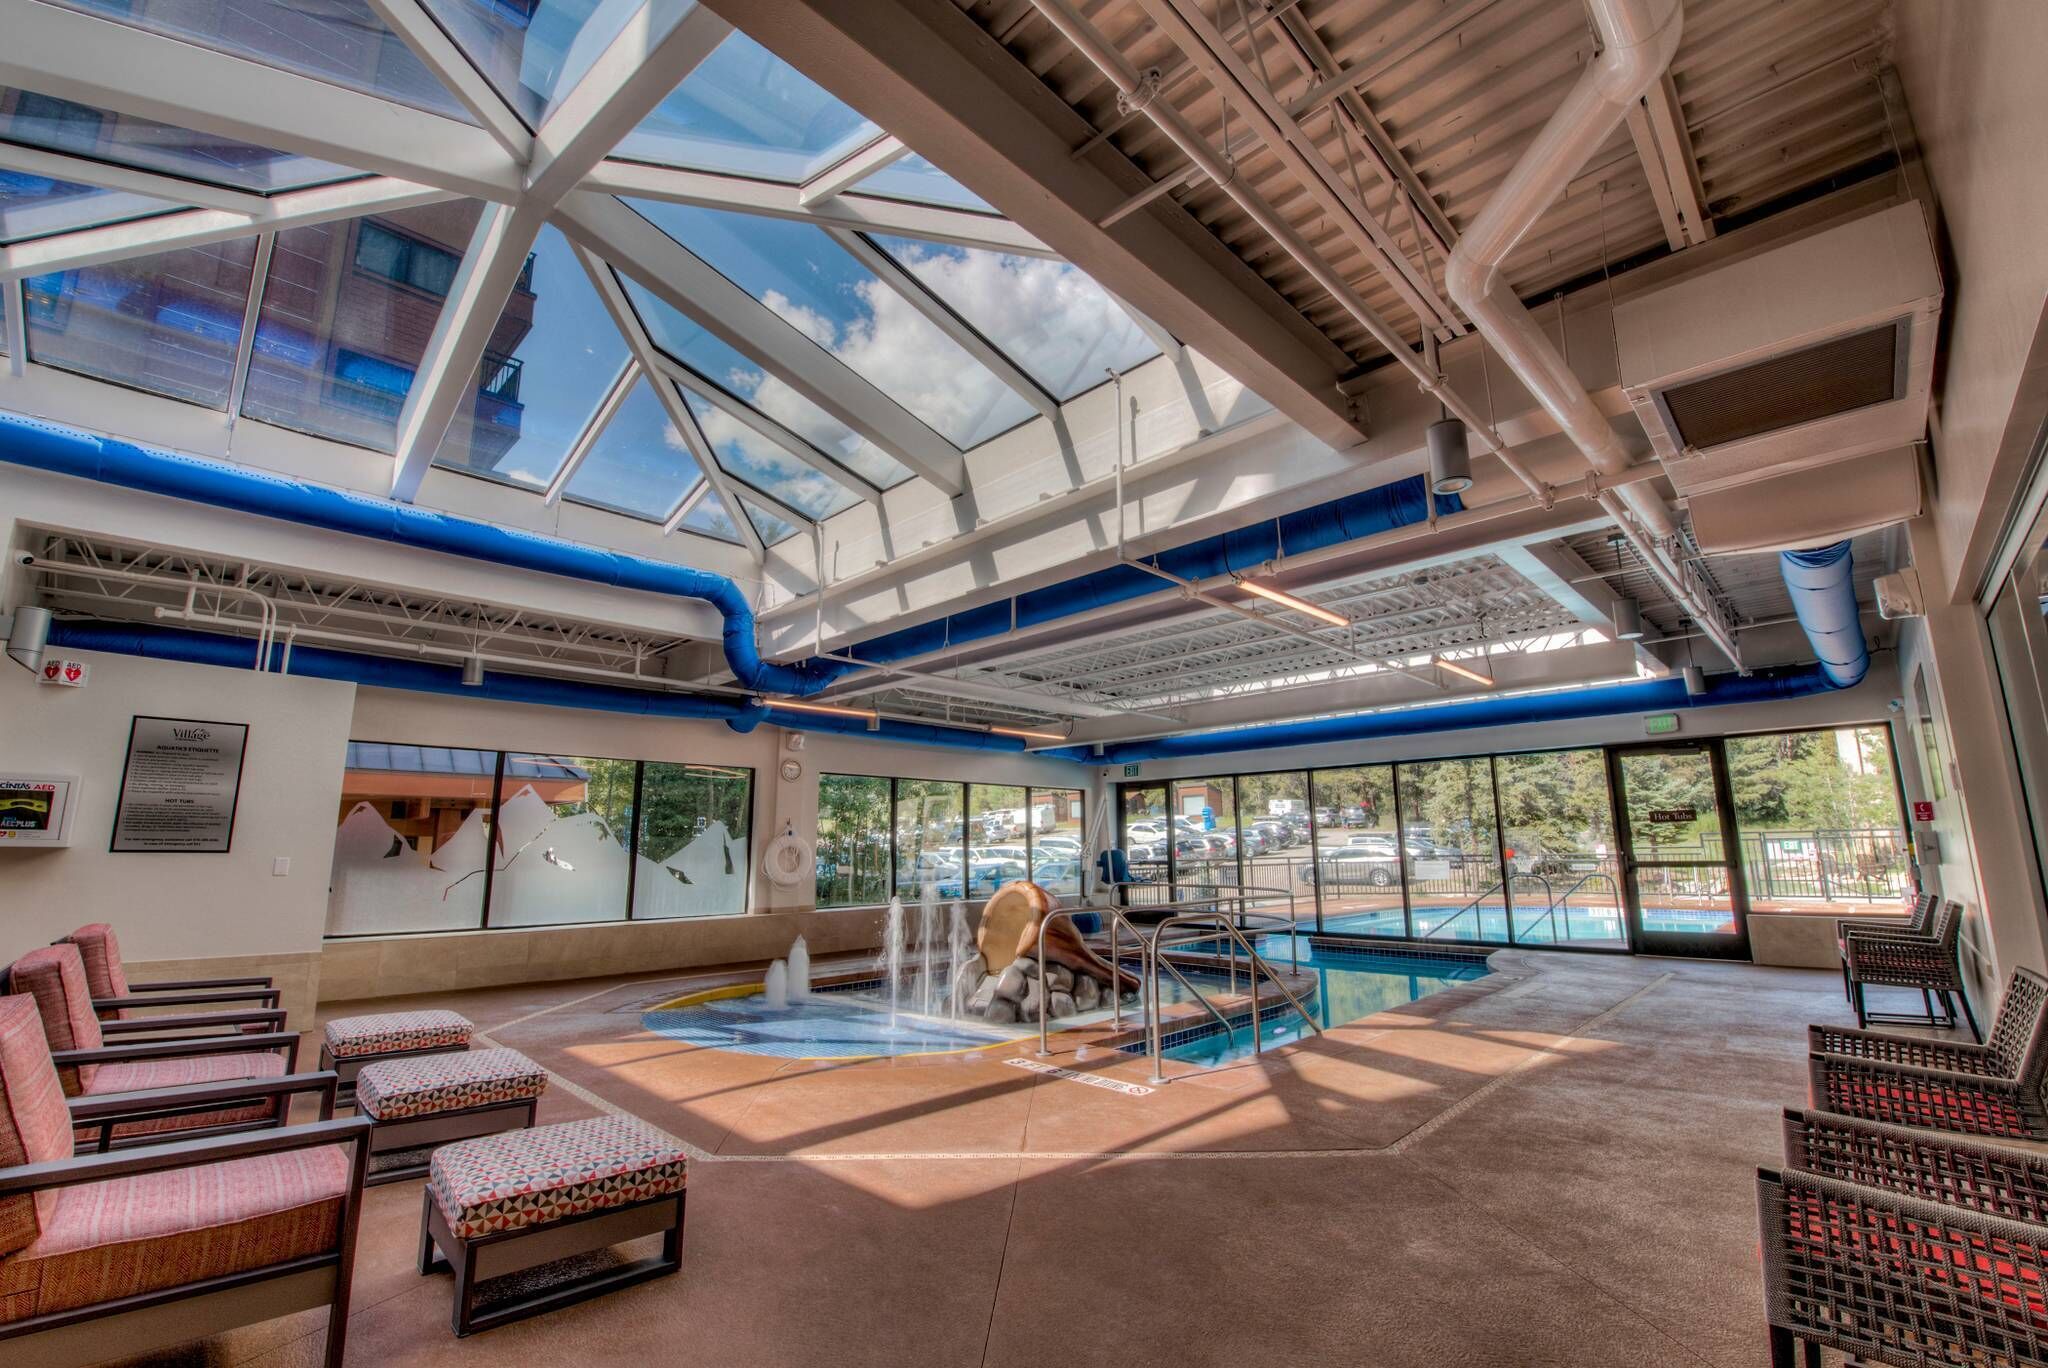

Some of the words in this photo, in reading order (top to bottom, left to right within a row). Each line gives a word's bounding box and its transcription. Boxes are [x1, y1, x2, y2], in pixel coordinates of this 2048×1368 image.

[172, 727, 211, 742] Village
[1126, 765, 1138, 776] EXIT
[34, 783, 55, 791] AED
[1654, 813, 1671, 821] Hot
[1674, 812, 1693, 820] Tubs
